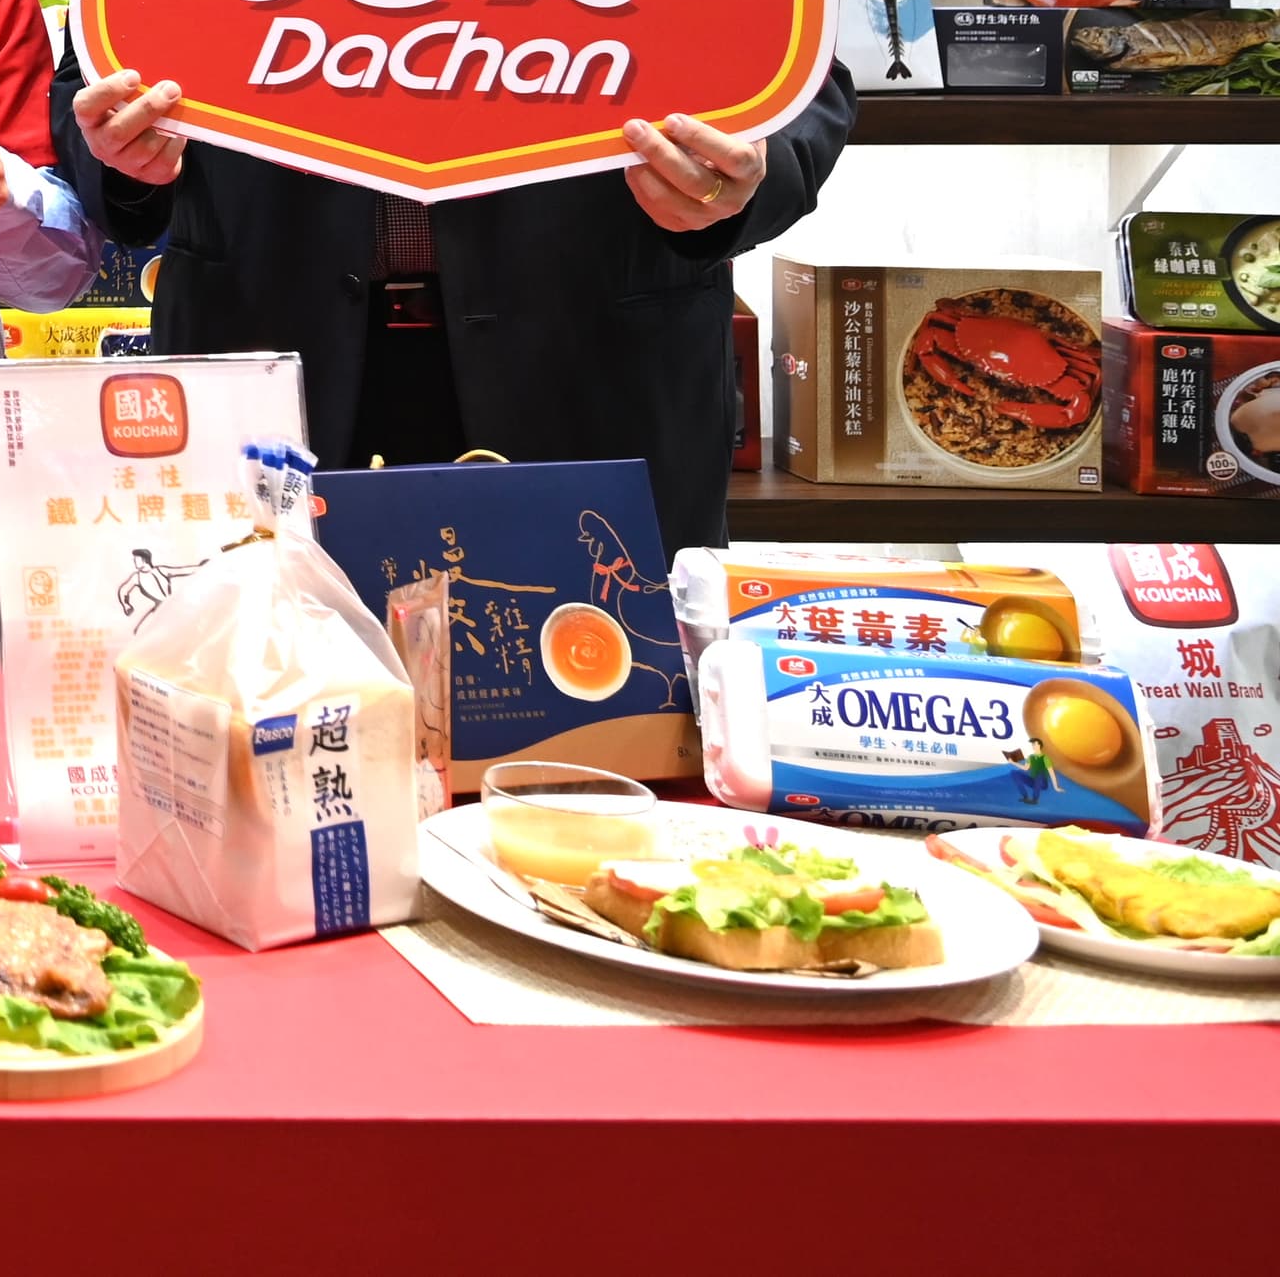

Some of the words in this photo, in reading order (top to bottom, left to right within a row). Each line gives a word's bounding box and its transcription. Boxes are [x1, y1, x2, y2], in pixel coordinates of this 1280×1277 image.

[248, 16, 631, 96] DaChan
[1073, 72, 1098, 82] CAS
[114, 388, 176, 423] 國成
[112, 424, 179, 439] KOUCHAN
[112, 465, 183, 490] 活性
[1133, 587, 1223, 603] KOUCHAN
[1176, 638, 1222, 679] 城
[1185, 681, 1223, 698] Wall
[1228, 682, 1264, 699] Brand
[809, 684, 834, 727] 大成
[837, 688, 1015, 741] OMEGA-3
[254, 726, 294, 745] Pasco
[310, 704, 354, 823] 超熟
